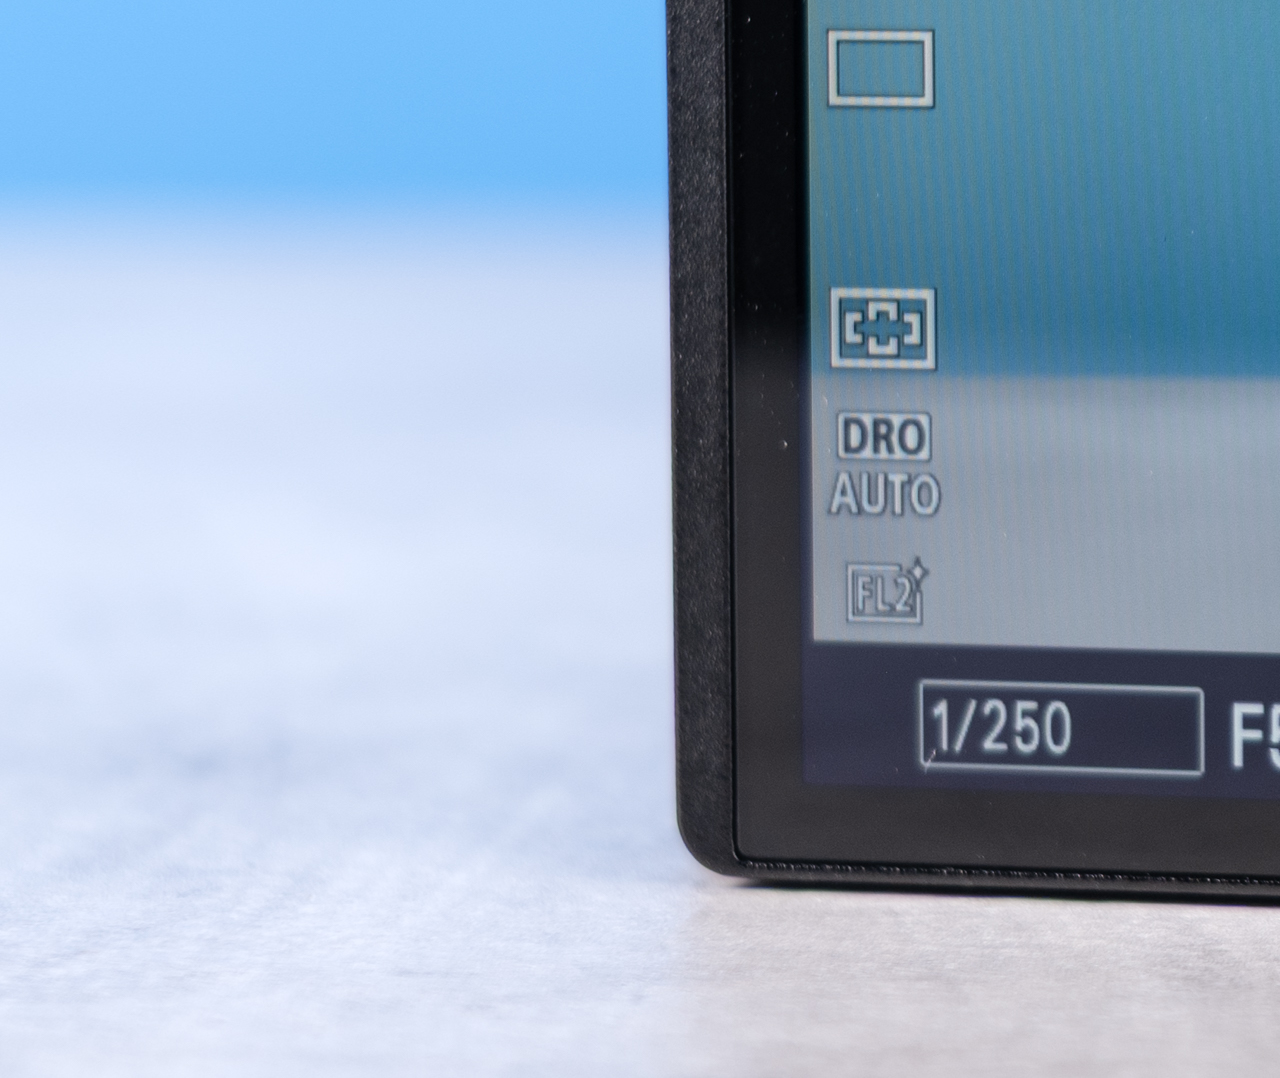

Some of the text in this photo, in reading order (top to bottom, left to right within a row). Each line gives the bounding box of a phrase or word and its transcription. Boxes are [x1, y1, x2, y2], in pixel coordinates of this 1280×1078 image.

[843, 417, 927, 455] DRO
[829, 471, 941, 516] AUTO
[855, 576, 914, 613] FL2
[932, 698, 1074, 755] 1/250
